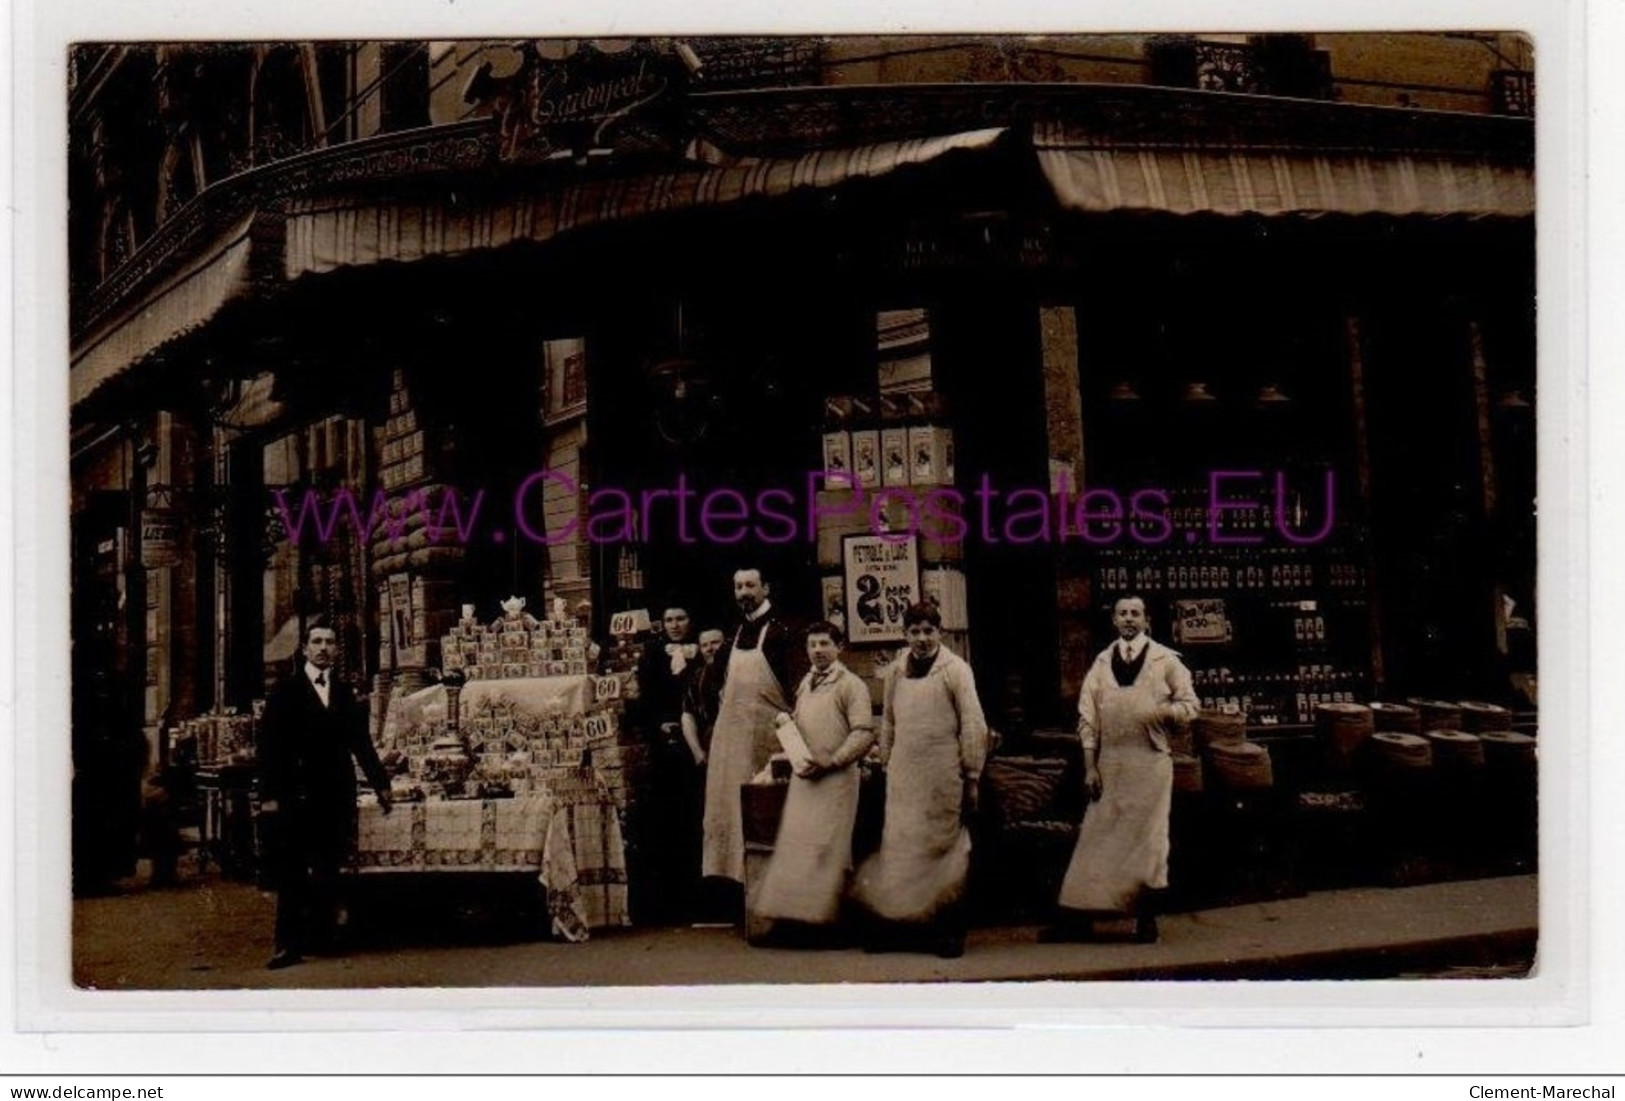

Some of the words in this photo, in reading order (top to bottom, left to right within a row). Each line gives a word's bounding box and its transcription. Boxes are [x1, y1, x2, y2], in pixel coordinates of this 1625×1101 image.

[613, 615, 633, 632] 60
[598, 679, 616, 697] 60
[586, 718, 607, 738] 60
